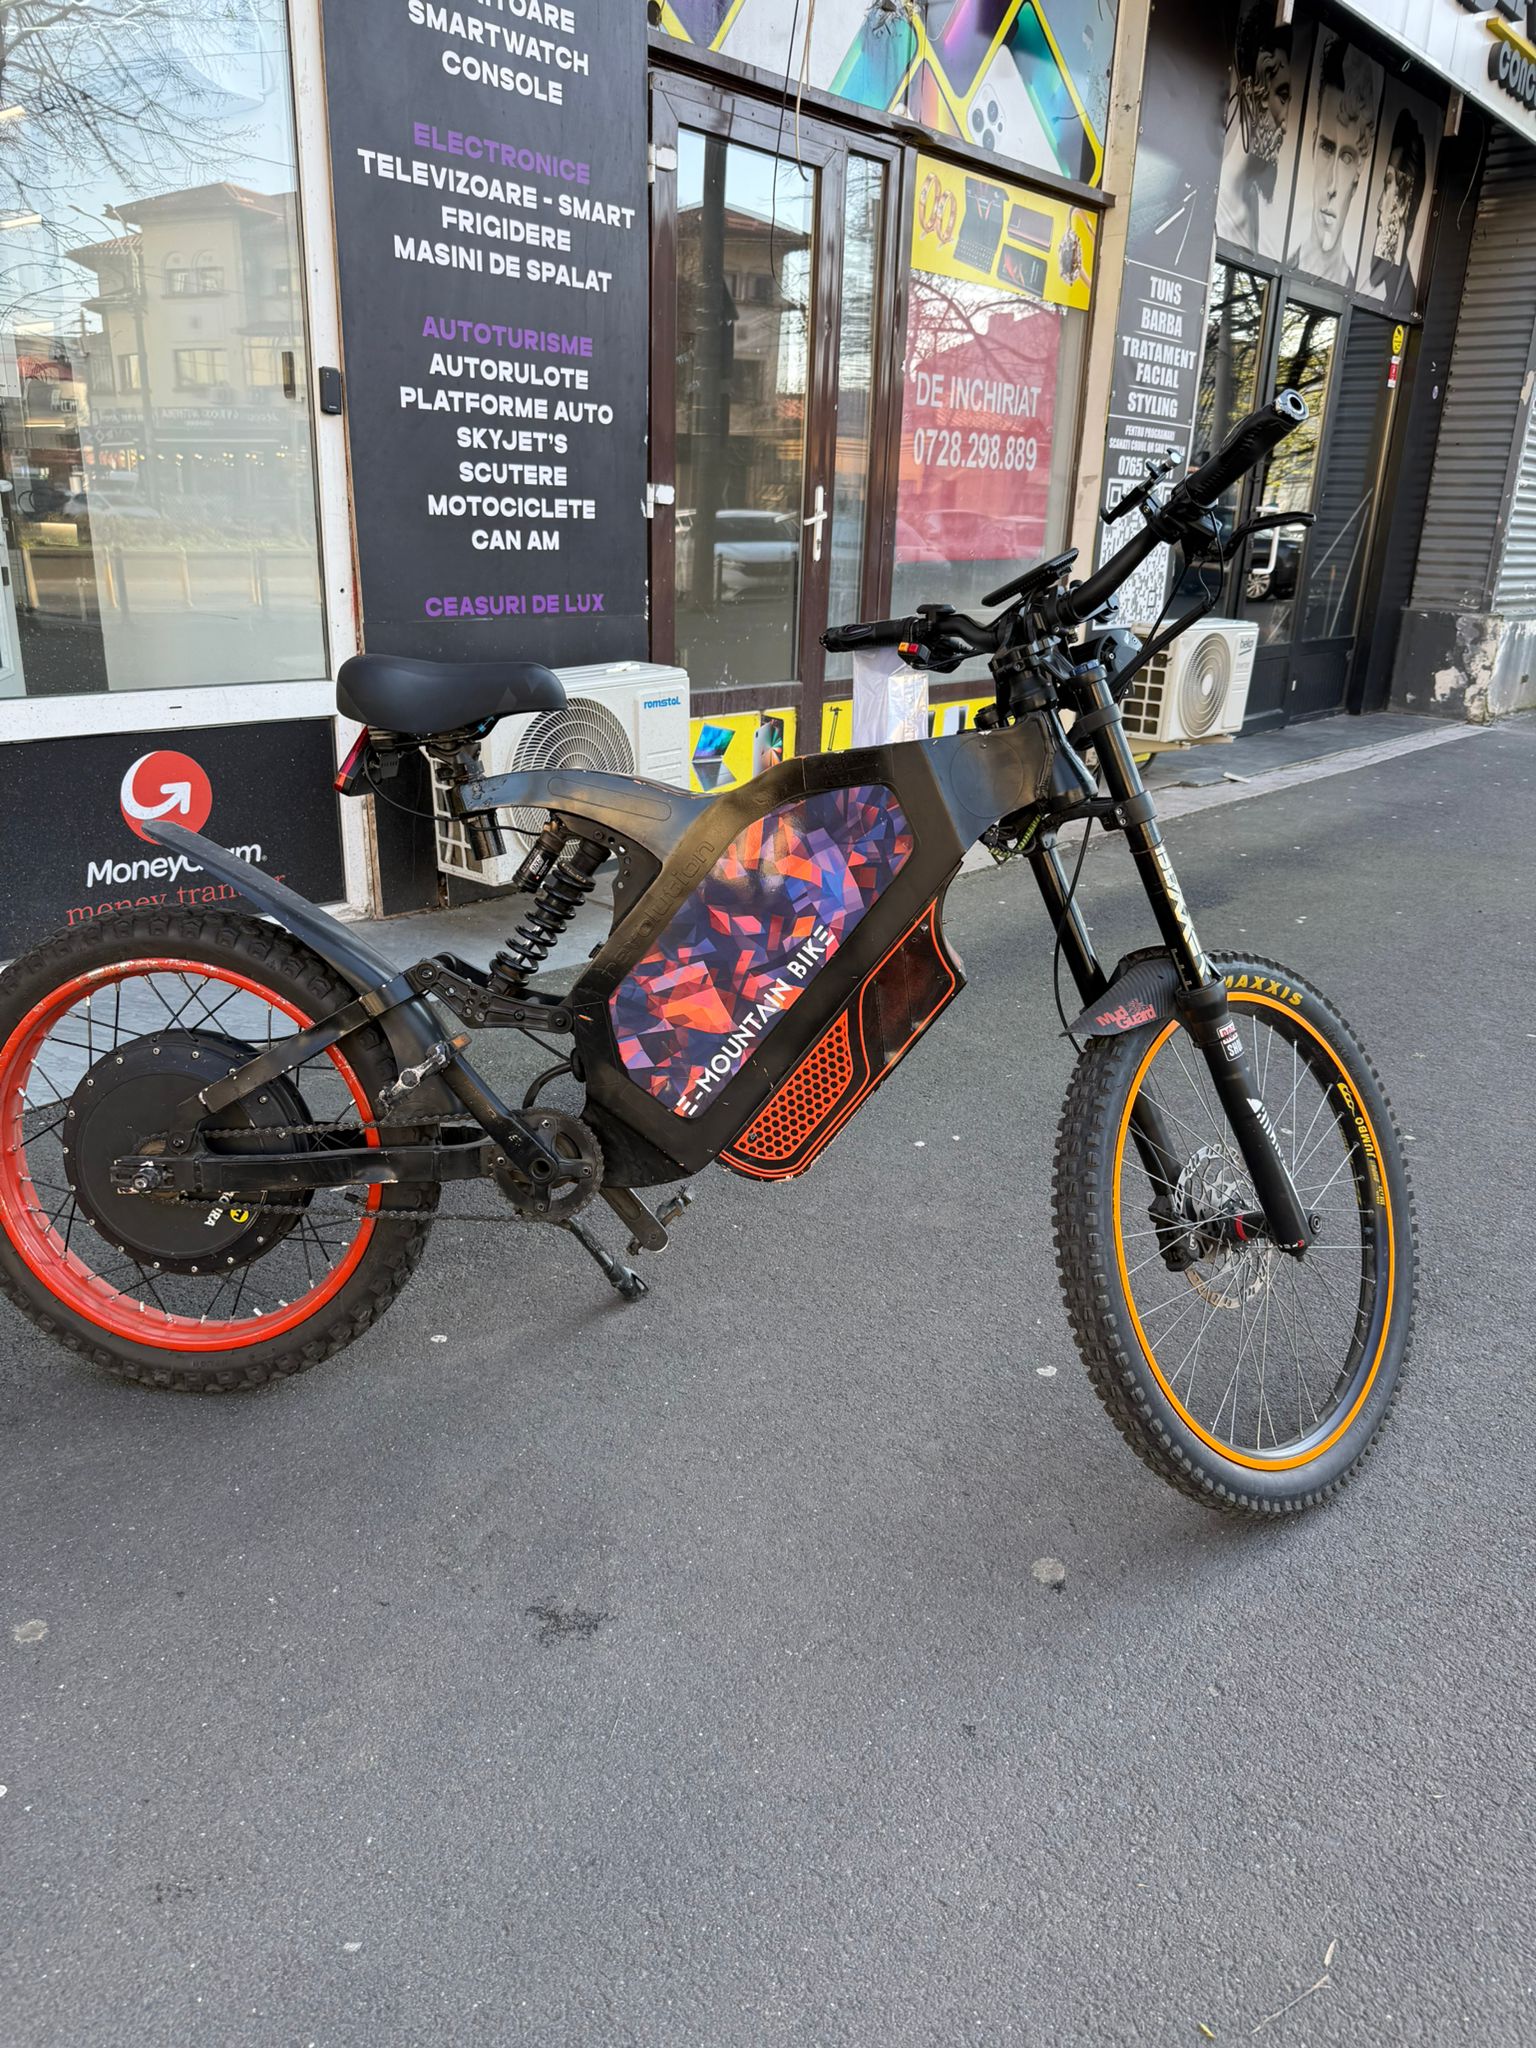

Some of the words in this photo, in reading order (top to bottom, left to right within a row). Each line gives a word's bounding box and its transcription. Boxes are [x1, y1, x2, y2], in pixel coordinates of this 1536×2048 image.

[408, 0, 589, 76] SMARTWATCH
[442, 50, 563, 106] CONSOLE
[414, 122, 590, 185] ELECTRONICE
[357, 148, 538, 209] TELEVIZOARE
[558, 194, 635, 229] SMART
[442, 205, 571, 252] FRIGIDERE
[394, 235, 483, 272] MASINI
[489, 253, 521, 279] DE
[526, 259, 612, 293] SPALAT
[1150, 276, 1182, 305] TUNS
[422, 316, 593, 357] AUTOTURISME
[1141, 307, 1182, 337] BARBA
[430, 353, 589, 390] AUTORULOTE
[1122, 336, 1197, 370] TRATAMENT
[917, 371, 944, 407] DE
[950, 377, 1042, 418] INCHIRIAT
[1135, 362, 1179, 389] FACIAL
[400, 386, 548, 420] PLATFORME
[554, 401, 614, 425] AUTO
[1127, 392, 1178, 418] STYLING
[456, 427, 568, 454] SKYJET'S
[913, 429, 1037, 471] 0728.298.889
[459, 462, 568, 487] SCUTERE
[1118, 455, 1143, 477] 0765
[428, 495, 596, 520] MOTOCICLETE
[471, 530, 522, 551] CAN
[527, 531, 560, 551] AM
[425, 596, 526, 617] CEASURI
[532, 594, 559, 614] DE
[565, 593, 604, 613] LUX
[87, 844, 262, 888] Moneym
[676, 977, 794, 1116] E-MOUNTAIN
[787, 924, 836, 980] BIKE
[1354, 1116, 1377, 1159] JUMBO
